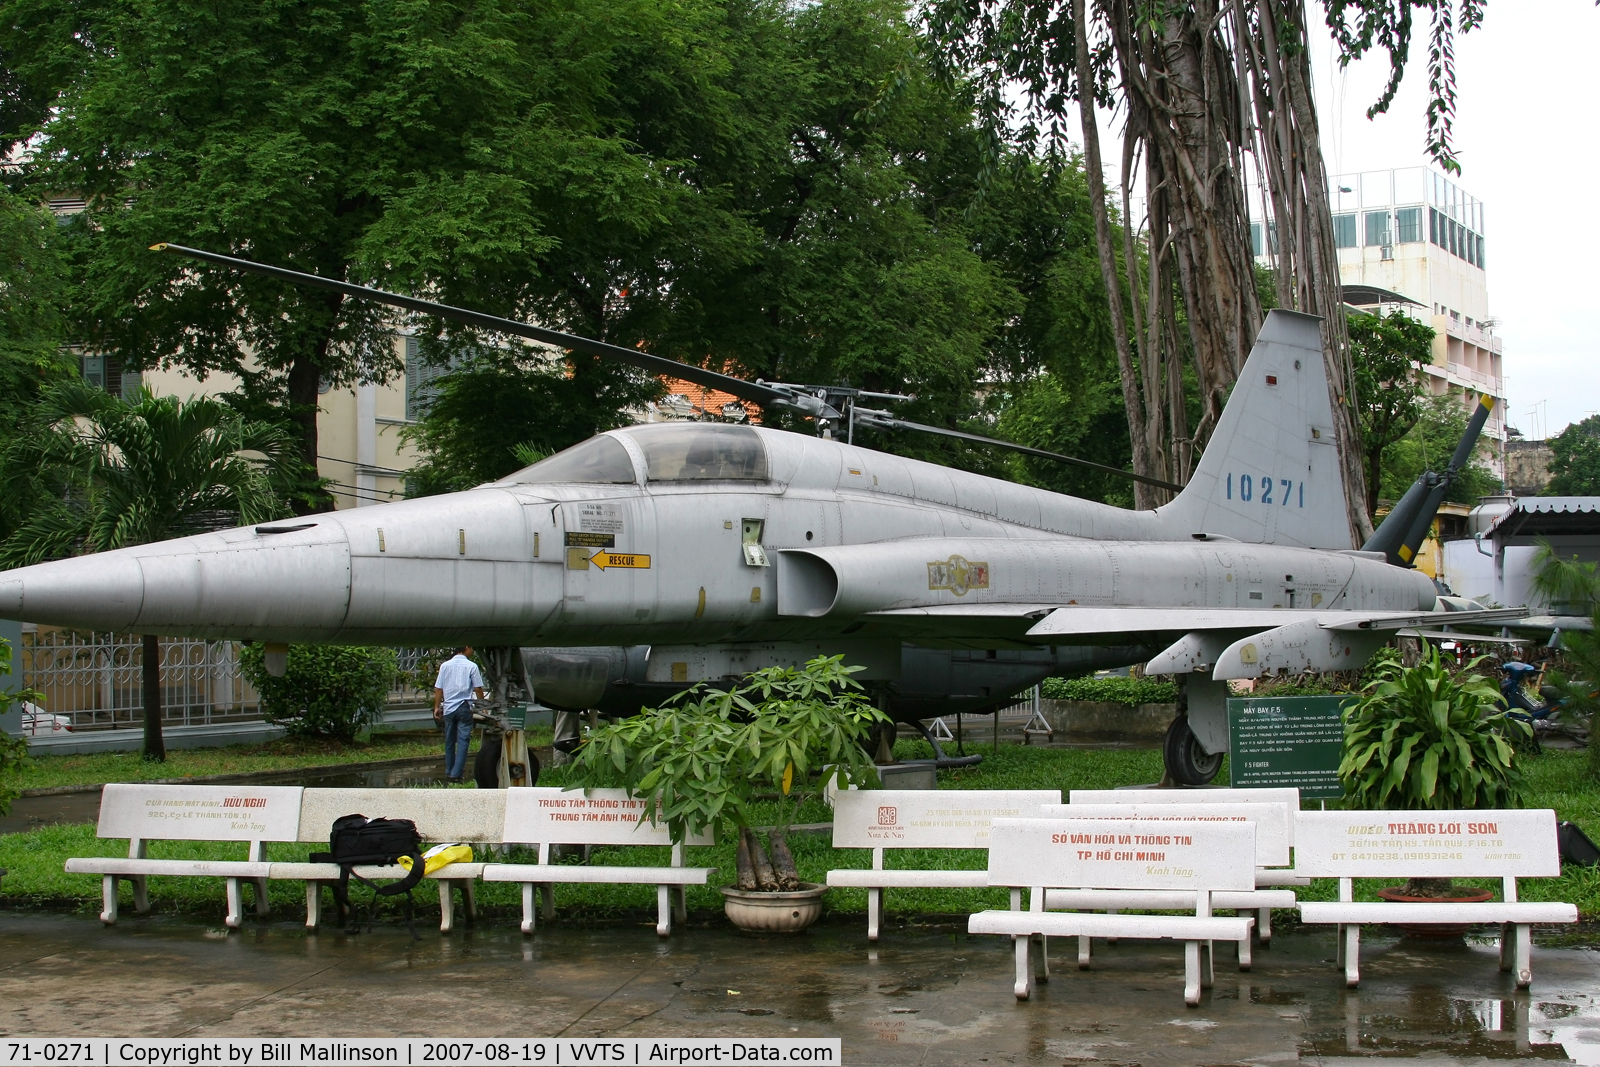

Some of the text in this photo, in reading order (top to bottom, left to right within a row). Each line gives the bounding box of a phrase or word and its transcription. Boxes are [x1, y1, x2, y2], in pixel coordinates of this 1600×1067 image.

[1227, 472, 1303, 508] 10271
[609, 556, 634, 565] RESCUE
[569, 798, 585, 807] TÂM
[588, 798, 618, 808] THÔNG
[582, 812, 597, 821] TÂM
[892, 832, 905, 840] Nay
[1070, 833, 1092, 844] VĂN
[1094, 831, 1115, 844] HÓA
[1134, 833, 1170, 845] THÔNG
[1174, 836, 1192, 845] TIN
[1096, 848, 1113, 860] HỒ
[1114, 848, 1136, 860] CHÍ
[1136, 852, 1165, 861] MINH
